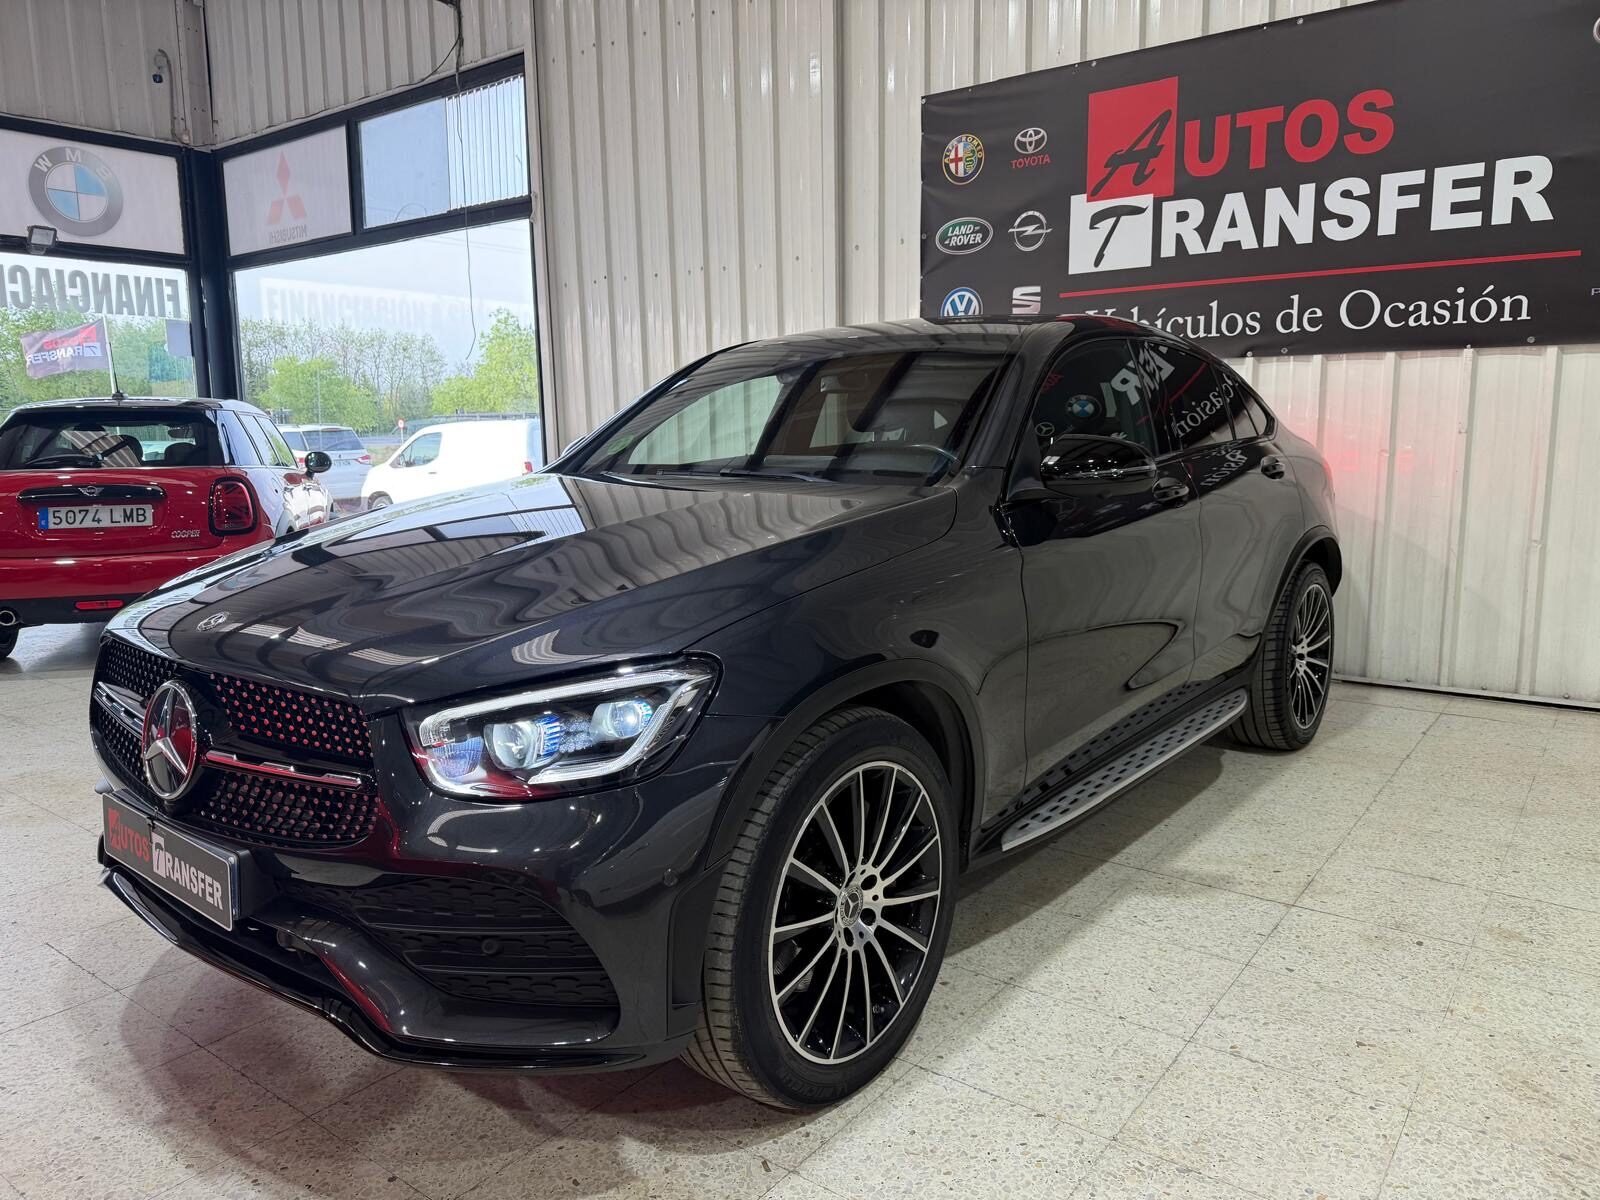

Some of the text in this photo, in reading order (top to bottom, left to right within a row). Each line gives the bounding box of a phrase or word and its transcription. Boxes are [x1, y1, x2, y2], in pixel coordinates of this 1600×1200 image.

[1010, 154, 1051, 169] TOYOTA
[1089, 88, 1395, 198] AUTOS
[947, 224, 974, 236] LAND
[1087, 155, 1554, 268] TRANSFER
[949, 233, 983, 247] ROVER
[1275, 294, 1323, 333] de
[1339, 284, 1531, 330] Ocasión
[52, 509, 103, 526] 5074
[110, 507, 147, 524] LMB
[108, 813, 150, 863] AUTOS
[153, 835, 223, 911] TRANSFER
